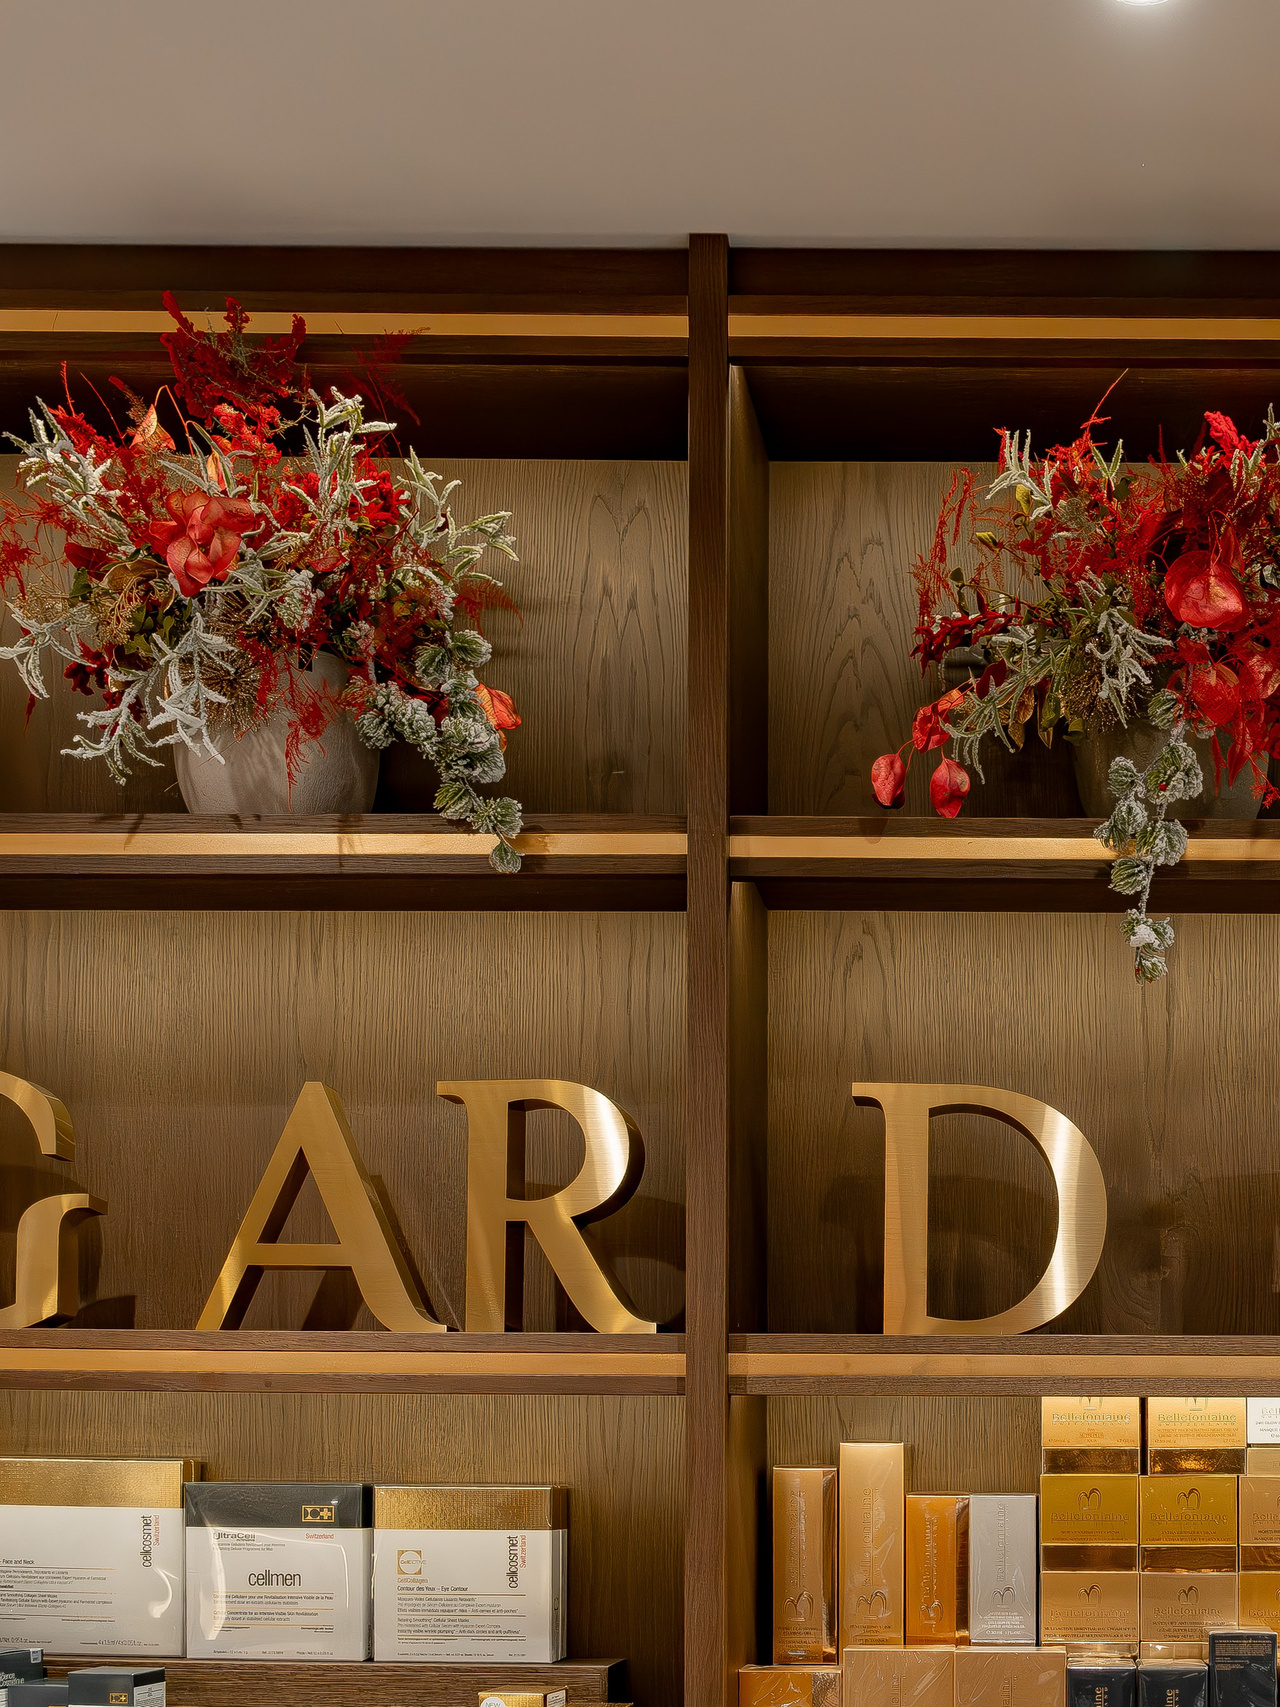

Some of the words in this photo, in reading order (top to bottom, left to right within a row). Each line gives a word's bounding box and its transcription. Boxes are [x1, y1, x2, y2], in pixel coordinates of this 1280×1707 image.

[1052, 1412, 1131, 1421] Bellefontaine
[1158, 1413, 1237, 1421] Bellefontaine
[140, 1515, 153, 1567] cellcosmet
[305, 1532, 335, 1540] Switzerland
[519, 1534, 527, 1569] Switzerland
[506, 1535, 519, 1589] cellcosmet
[248, 1570, 301, 1587] cellmen
